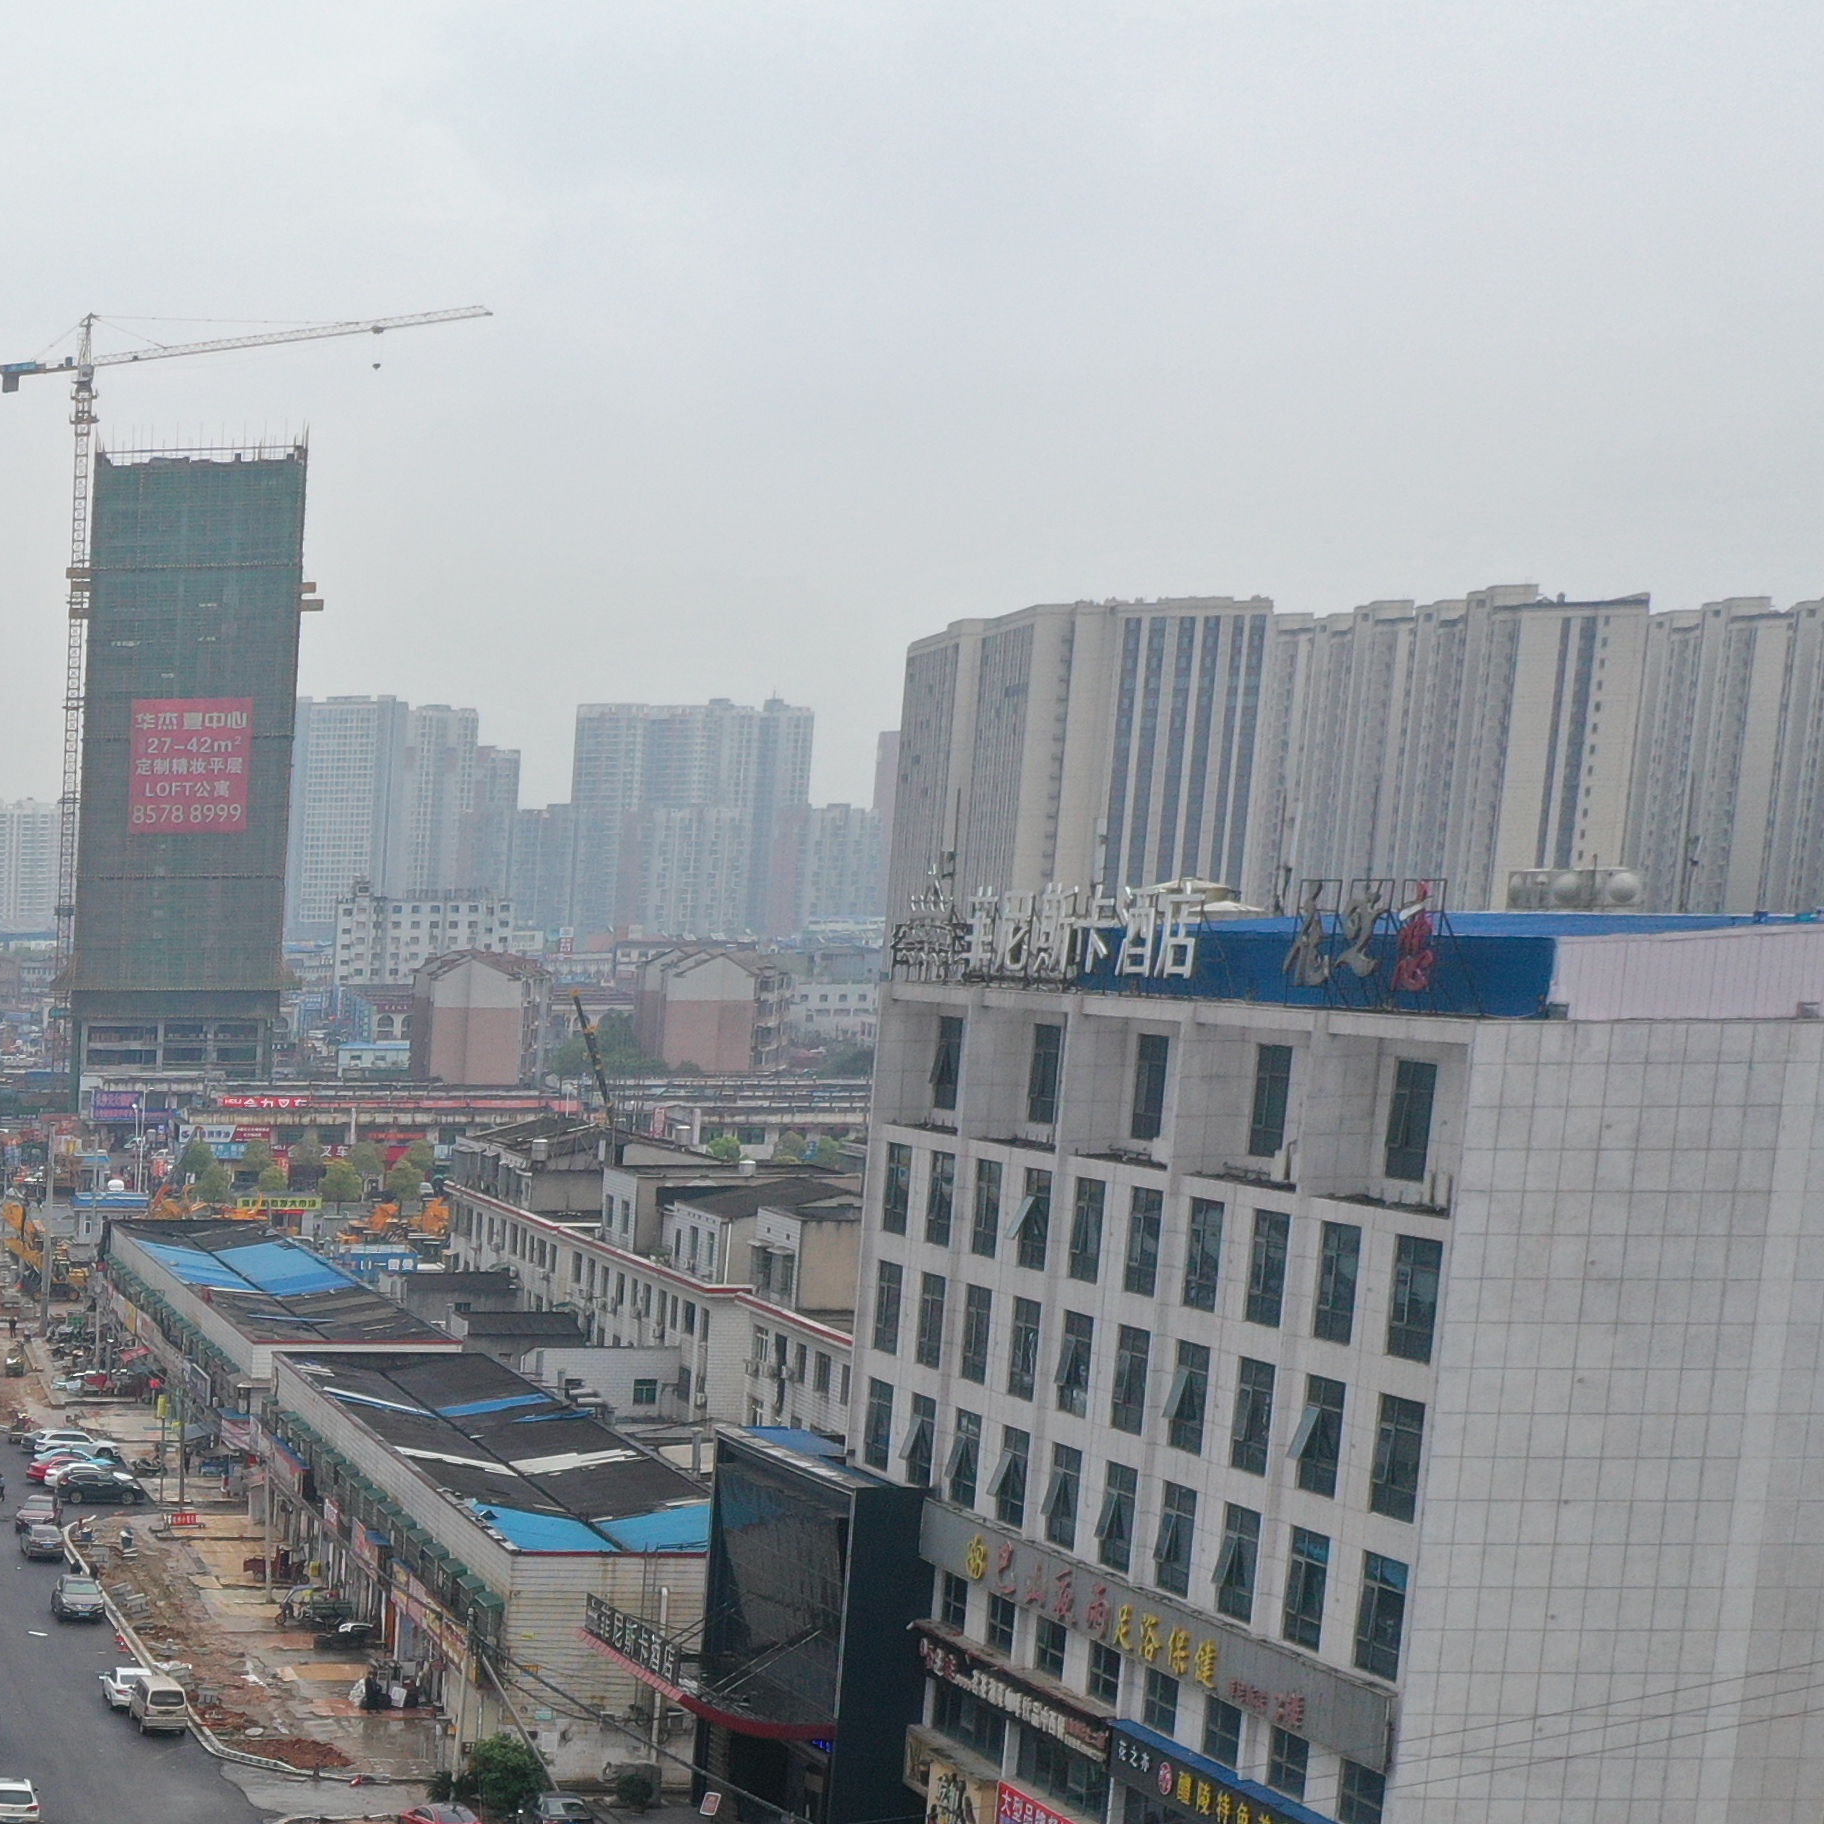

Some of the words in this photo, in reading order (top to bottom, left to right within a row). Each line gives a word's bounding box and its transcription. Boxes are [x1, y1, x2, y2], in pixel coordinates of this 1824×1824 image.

[145, 780, 231, 798] LOFT公寓
[132, 804, 184, 824] 8578
[189, 803, 242, 823] 8999
